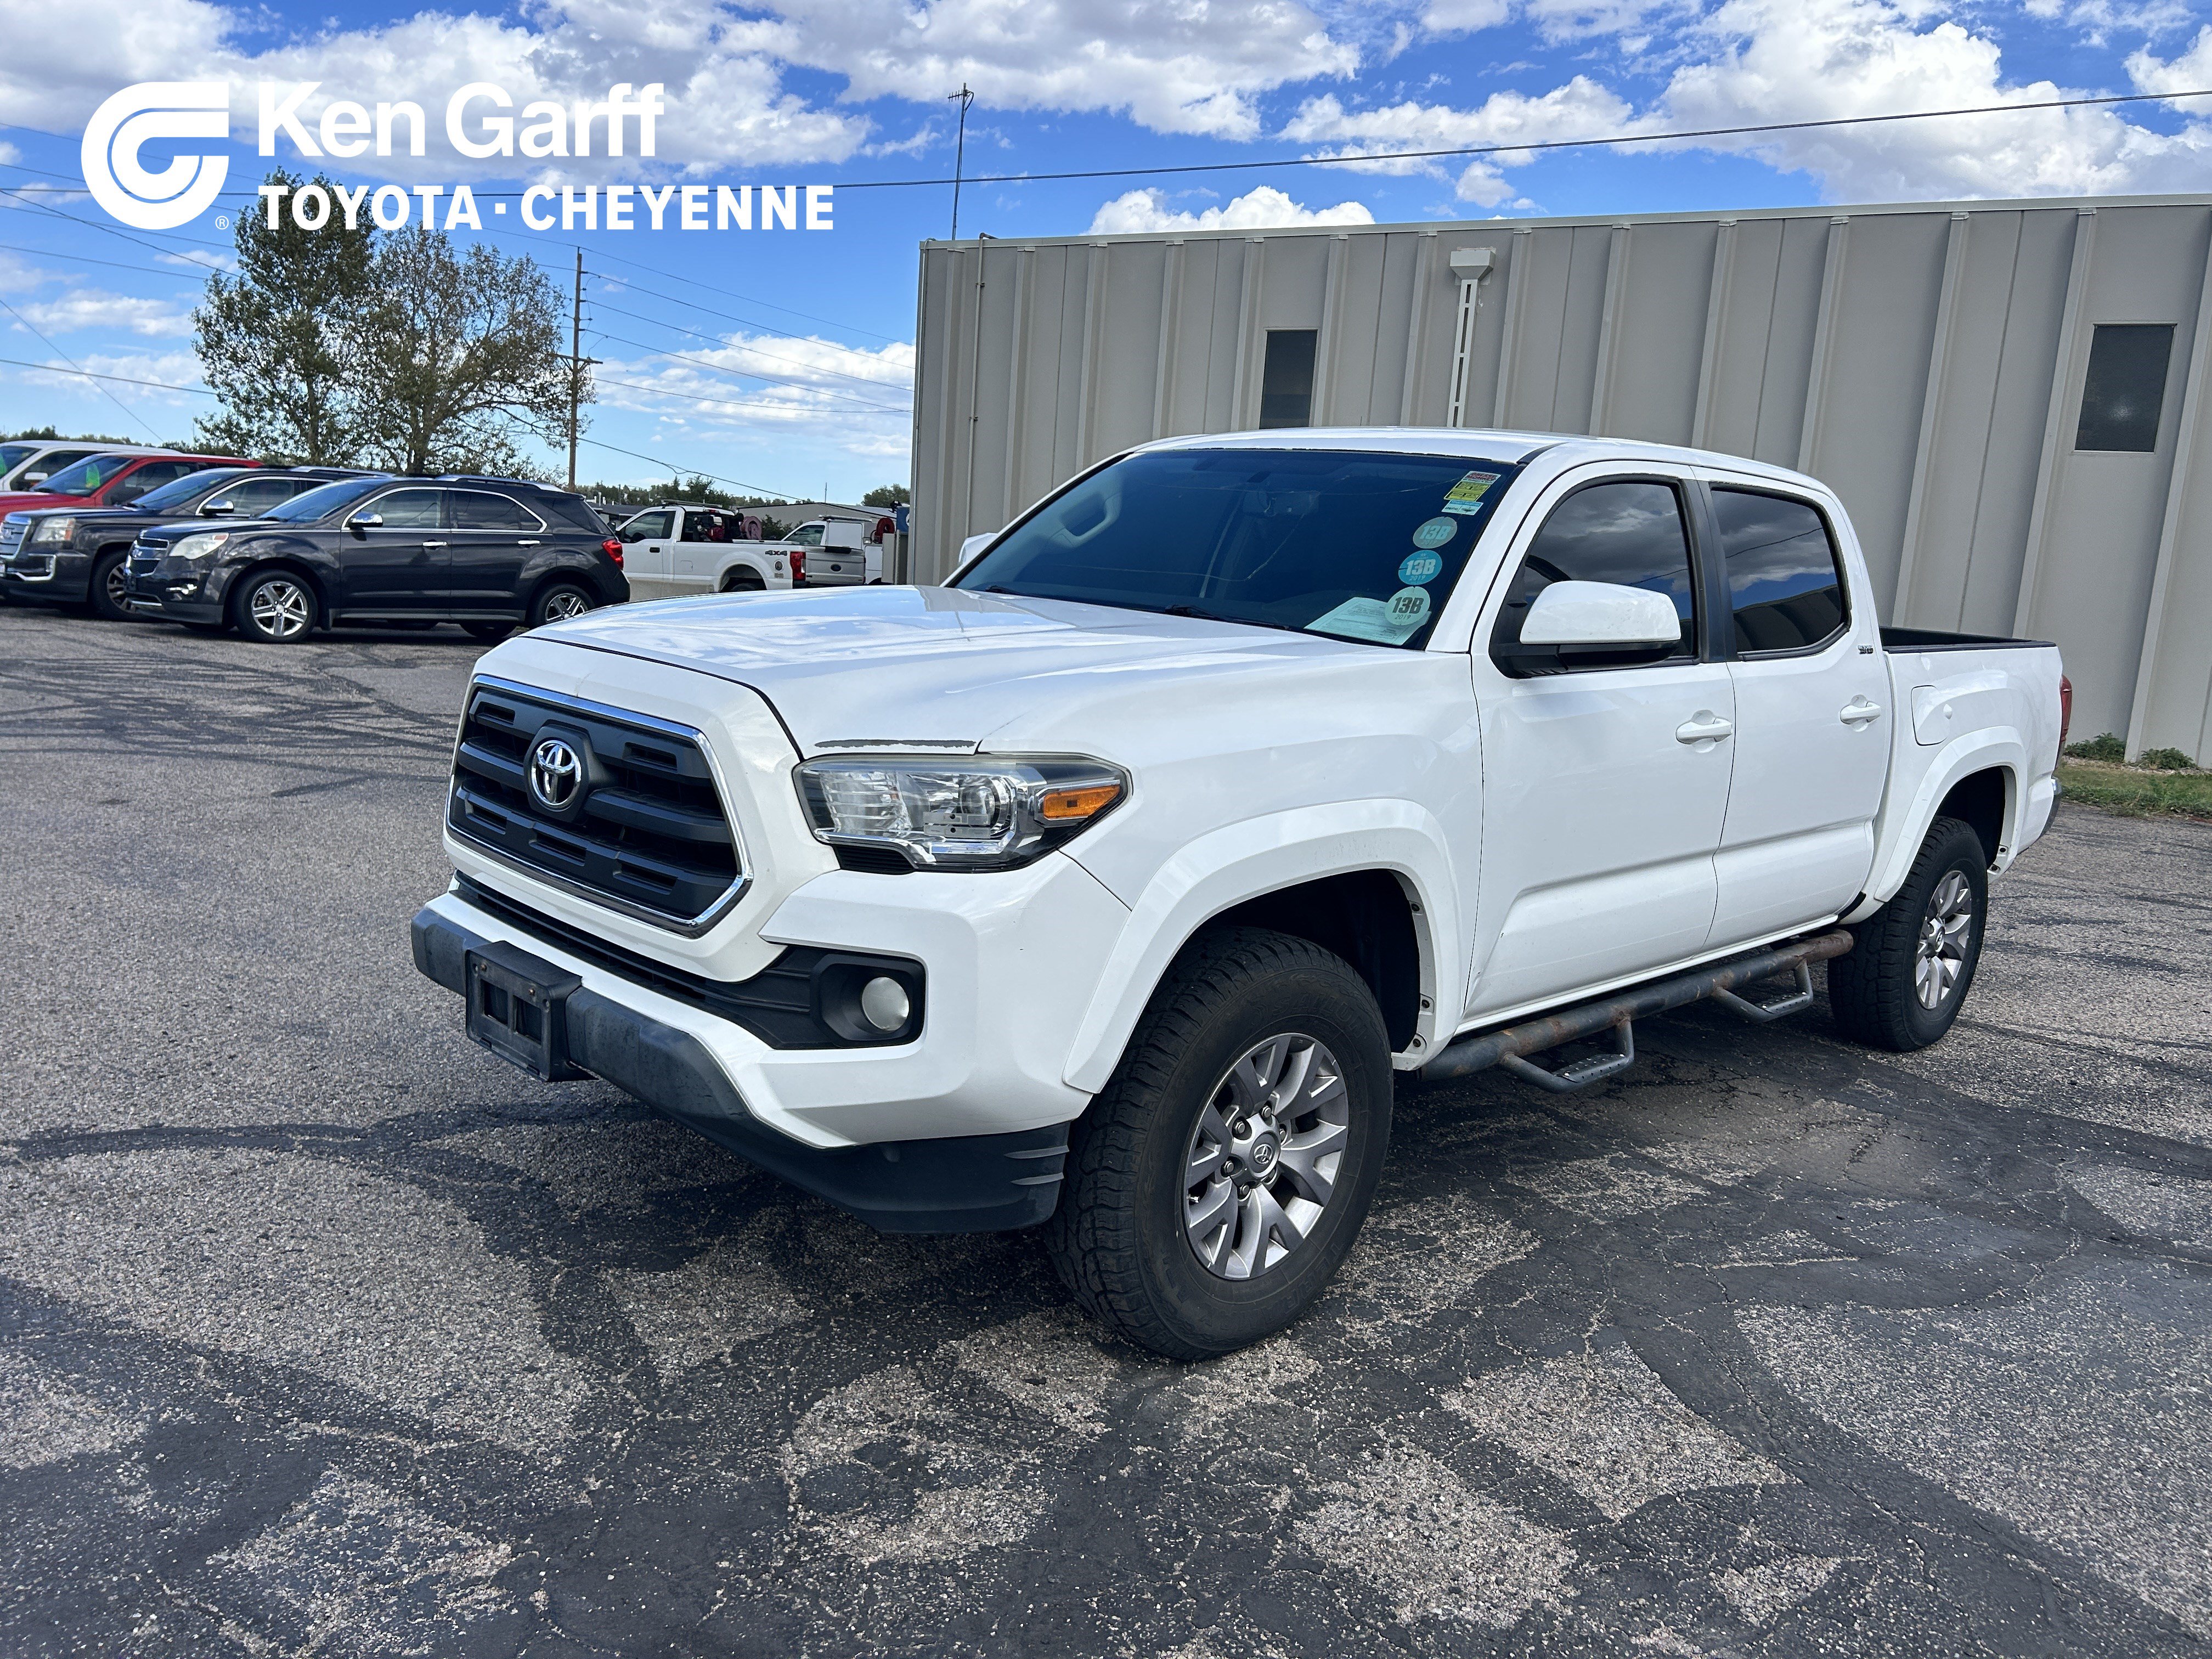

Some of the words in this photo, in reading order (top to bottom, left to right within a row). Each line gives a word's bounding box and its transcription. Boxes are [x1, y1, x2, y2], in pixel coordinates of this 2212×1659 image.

[1420, 525, 1451, 540] 13B
[1406, 559, 1436, 575] 13B
[1392, 597, 1424, 614] 13B
